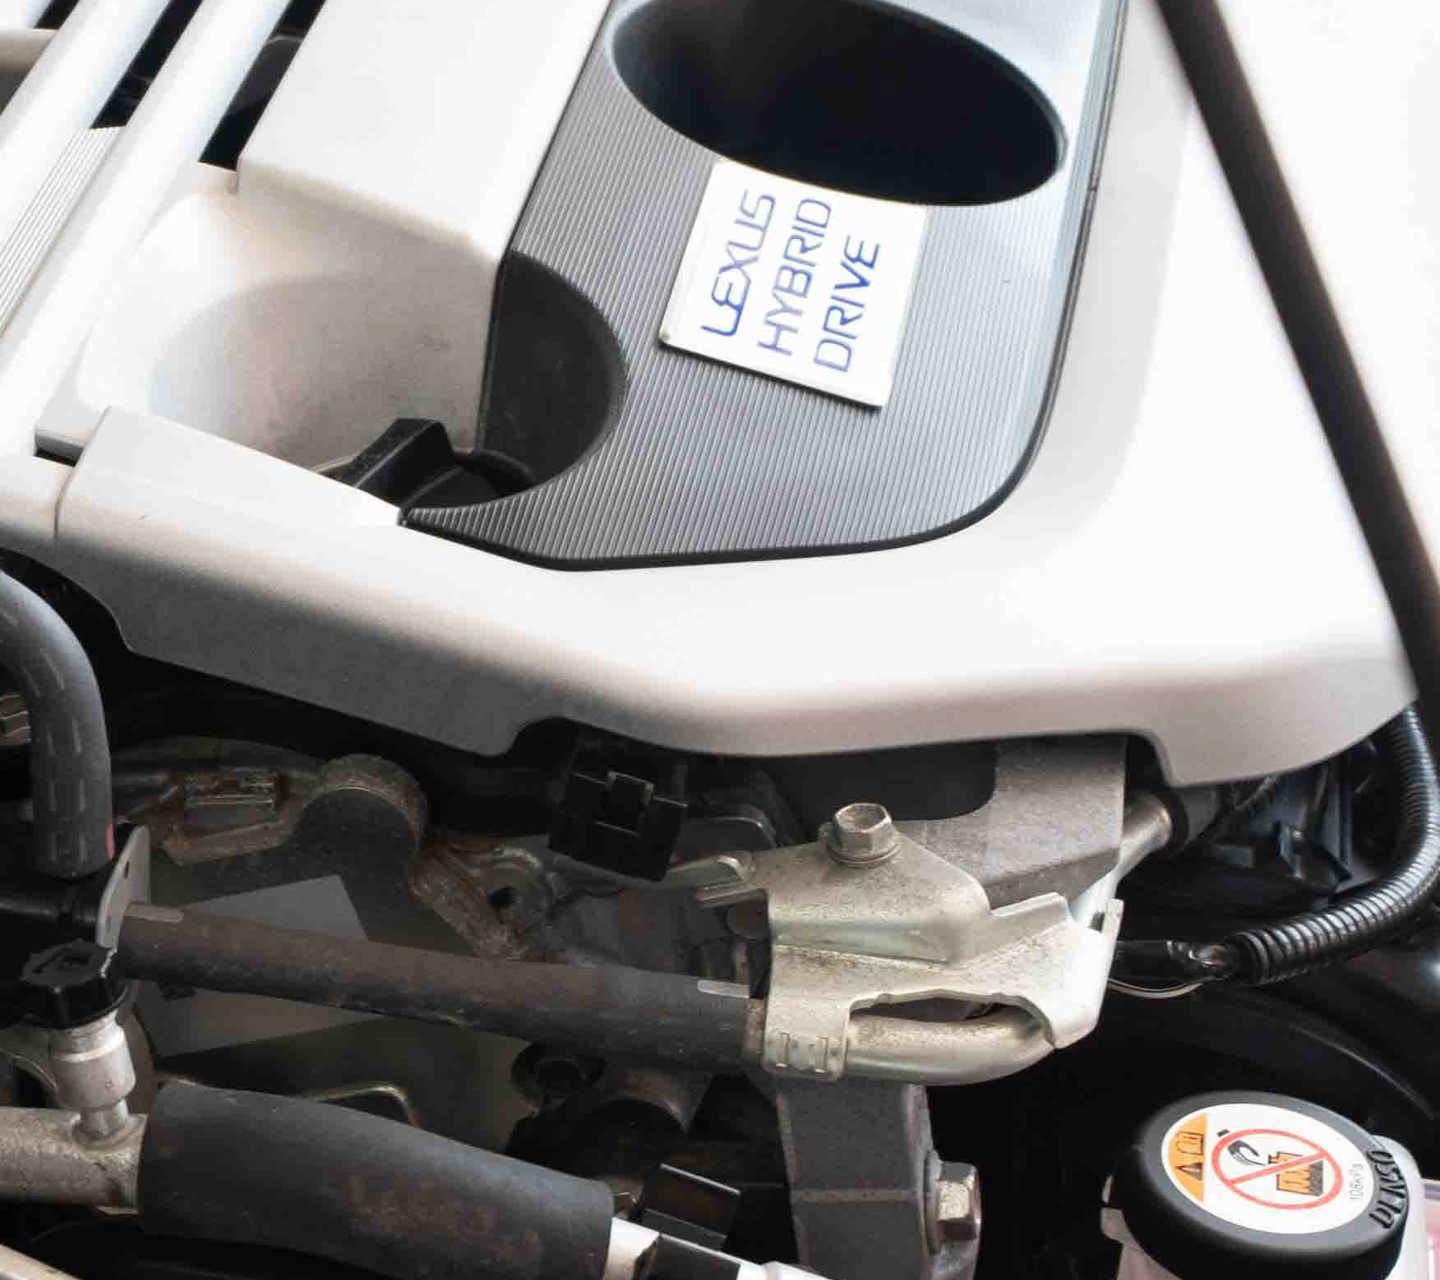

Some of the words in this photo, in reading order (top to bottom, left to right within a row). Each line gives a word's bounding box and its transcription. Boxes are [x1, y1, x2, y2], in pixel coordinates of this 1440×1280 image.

[701, 188, 777, 337] LEXUS
[757, 197, 832, 356] HYBRID
[813, 233, 881, 373] DRIVE
